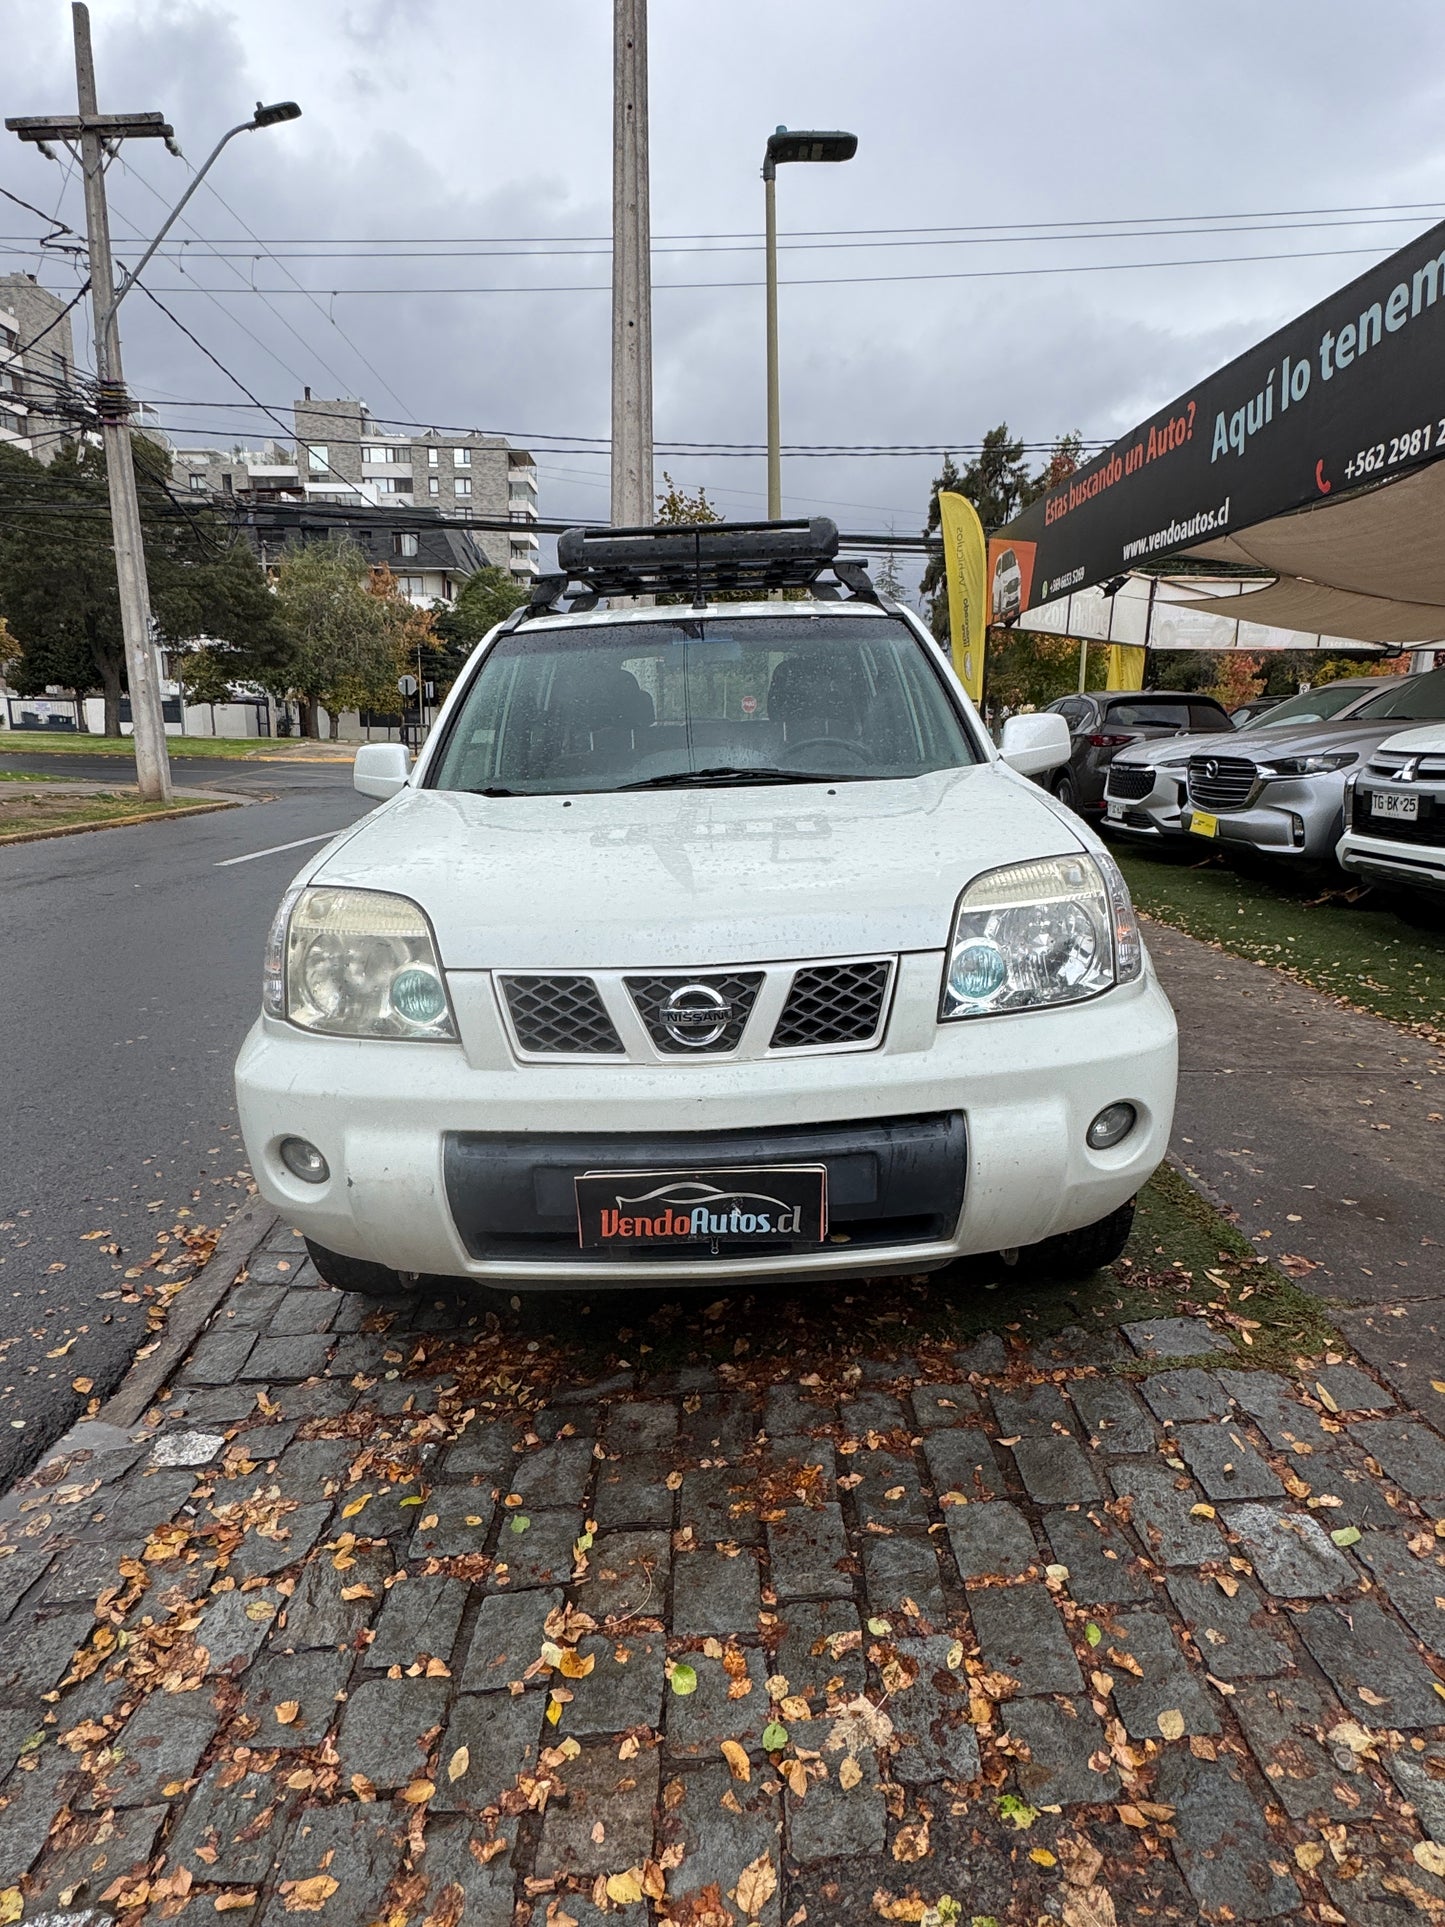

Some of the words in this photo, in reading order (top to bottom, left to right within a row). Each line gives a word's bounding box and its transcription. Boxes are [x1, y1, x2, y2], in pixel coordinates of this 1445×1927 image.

[1211, 367, 1276, 464] Aquí
[1281, 355, 1311, 412] lo
[1044, 493, 1068, 527] Estas
[1068, 452, 1122, 511] buscando
[1125, 442, 1144, 476] un
[1145, 400, 1197, 464] Auto?
[1344, 443, 1385, 480] +562
[1387, 424, 1432, 465] 2981
[1123, 496, 1230, 561] www.vendoautos.cl
[667, 1012, 725, 1022] NISSAN
[600, 1205, 802, 1238] VendoAutos.cl
